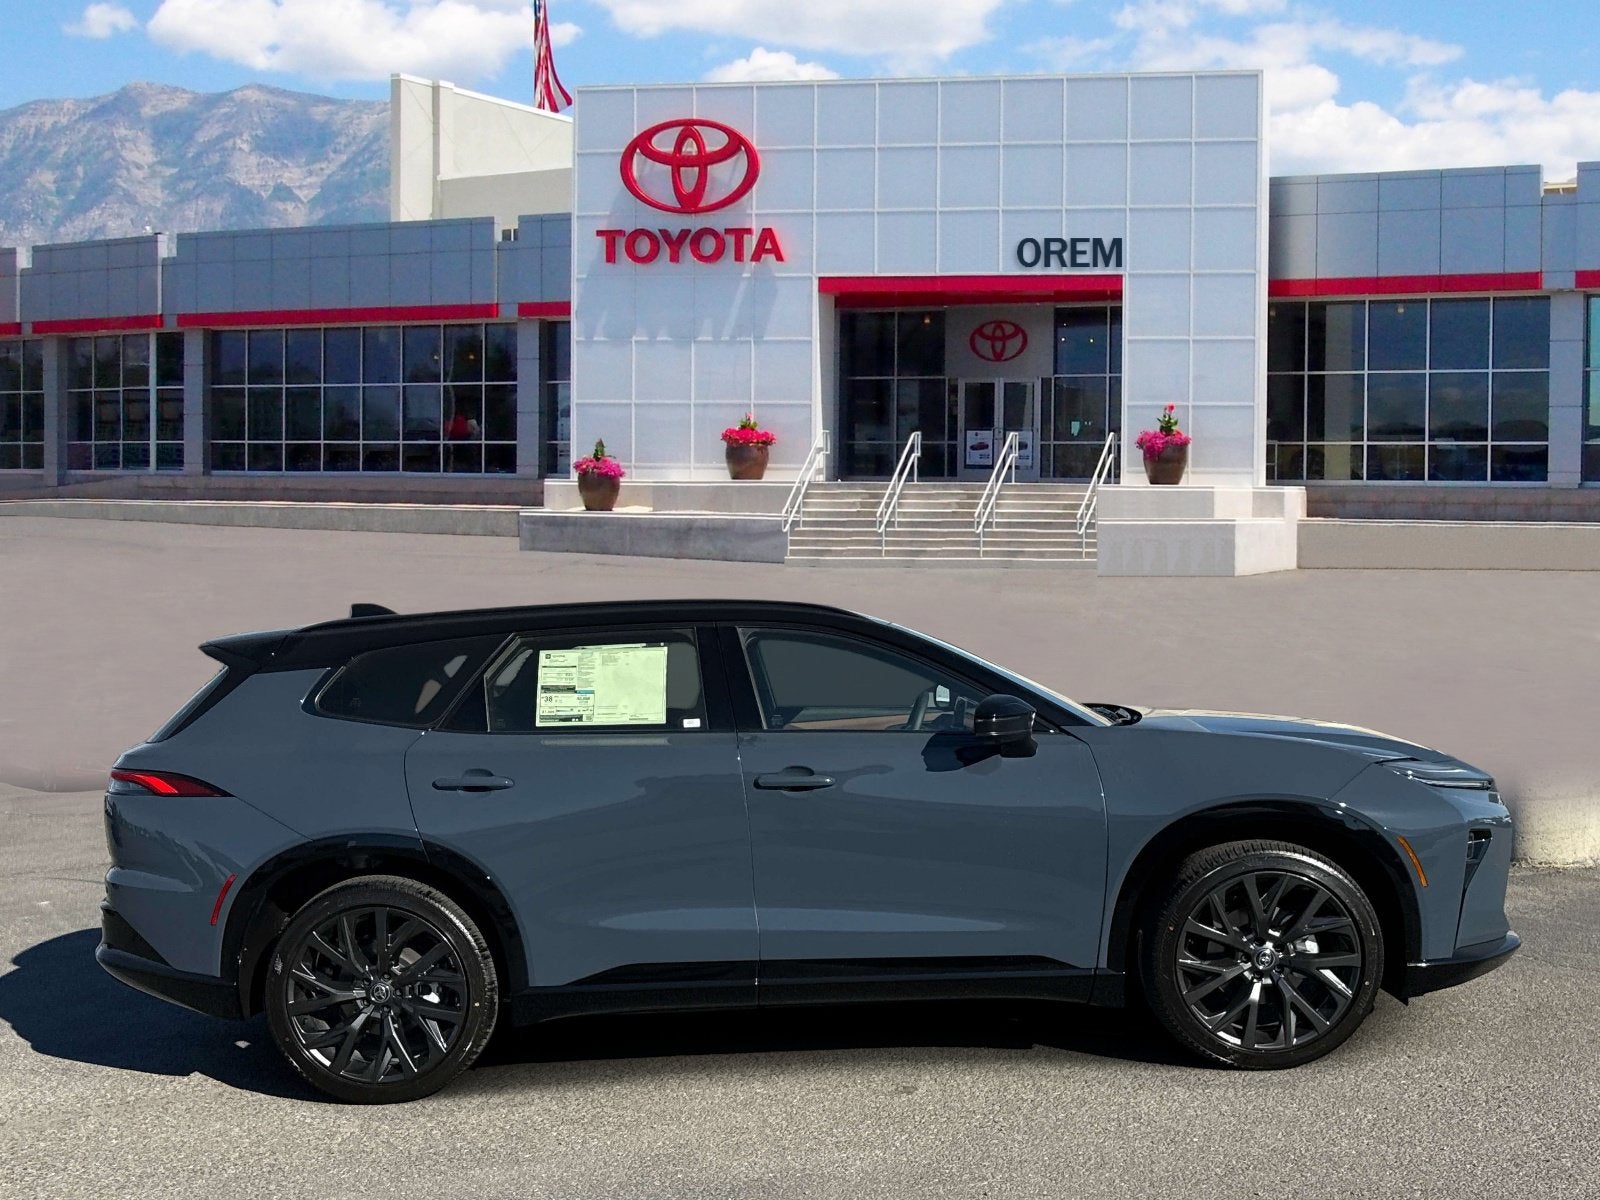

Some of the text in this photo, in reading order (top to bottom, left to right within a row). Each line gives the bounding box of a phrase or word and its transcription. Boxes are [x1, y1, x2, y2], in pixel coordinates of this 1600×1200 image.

[596, 227, 784, 264] TOYOTA
[1017, 238, 1123, 267] OREM
[544, 695, 553, 703] 38
